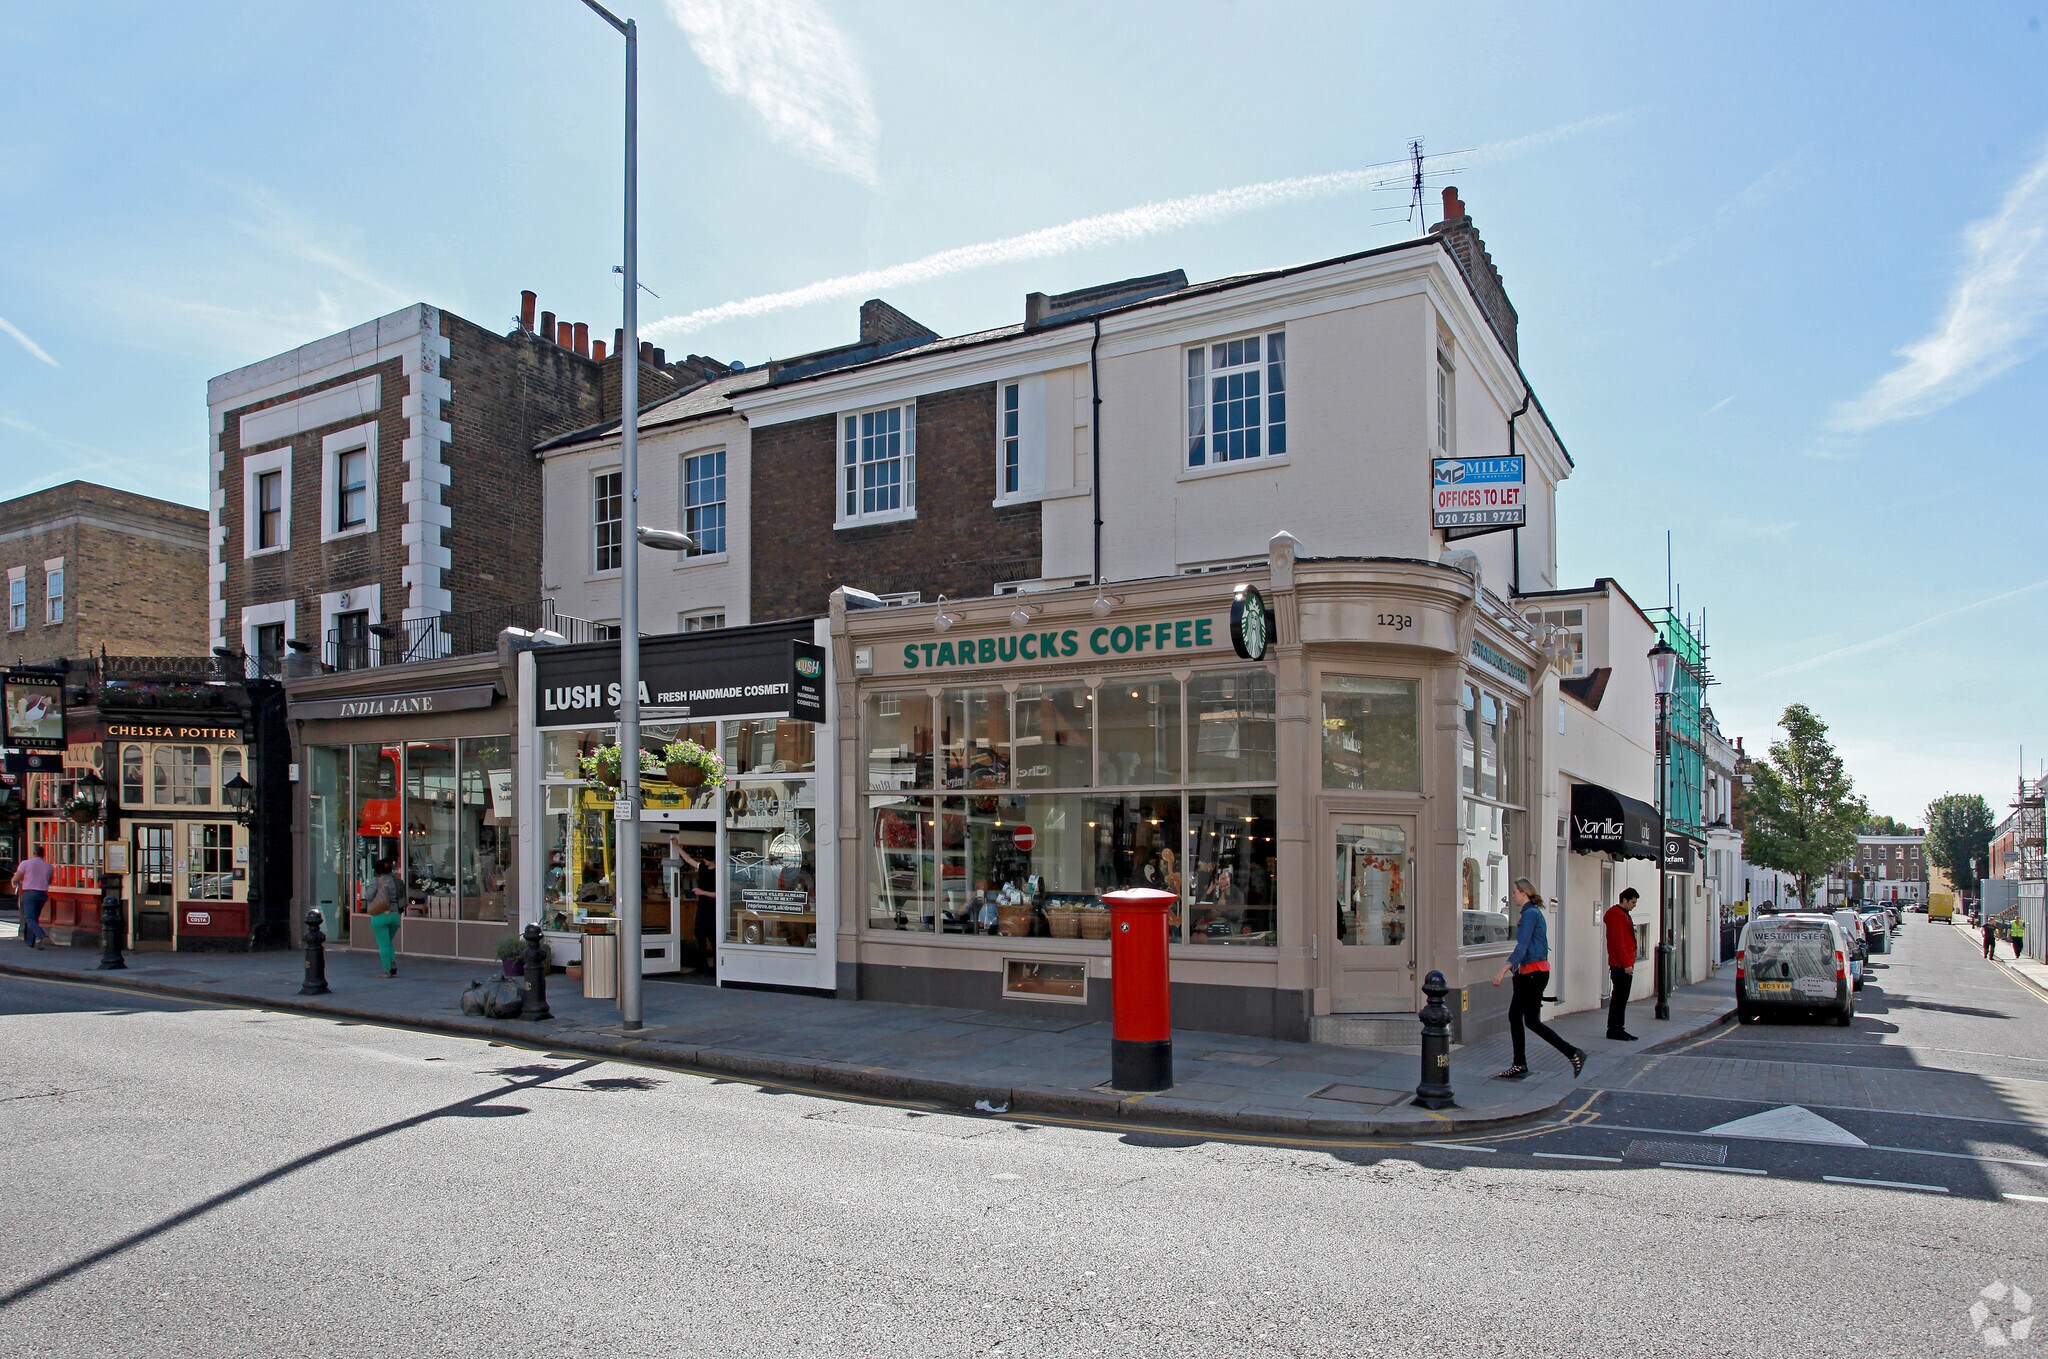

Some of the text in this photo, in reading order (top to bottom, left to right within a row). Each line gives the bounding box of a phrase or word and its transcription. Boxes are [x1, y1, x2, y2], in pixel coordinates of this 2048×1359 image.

[1466, 459, 1519, 474] MILES
[1438, 488, 1520, 507] OFFICES TO LET
[1438, 511, 1520, 524] 020 7581 9722
[1377, 613, 1412, 631] 123a
[904, 618, 1213, 669] STARBUCKS COFFEE
[797, 660, 820, 674] LUSH
[8, 676, 58, 686] CHELSEA
[545, 680, 651, 711] LUSH SA
[657, 682, 789, 703] FRESH HANDMADE COSMETI
[797, 691, 820, 701] HANDMADE
[801, 685, 816, 693] FRESH
[340, 697, 433, 717] INDIA JANE
[796, 699, 820, 708] COSMETICS
[107, 725, 237, 738] CHELSEA POTTER
[1574, 815, 1624, 835] Vanilla
[1755, 932, 1827, 940] WESTMINSTER
